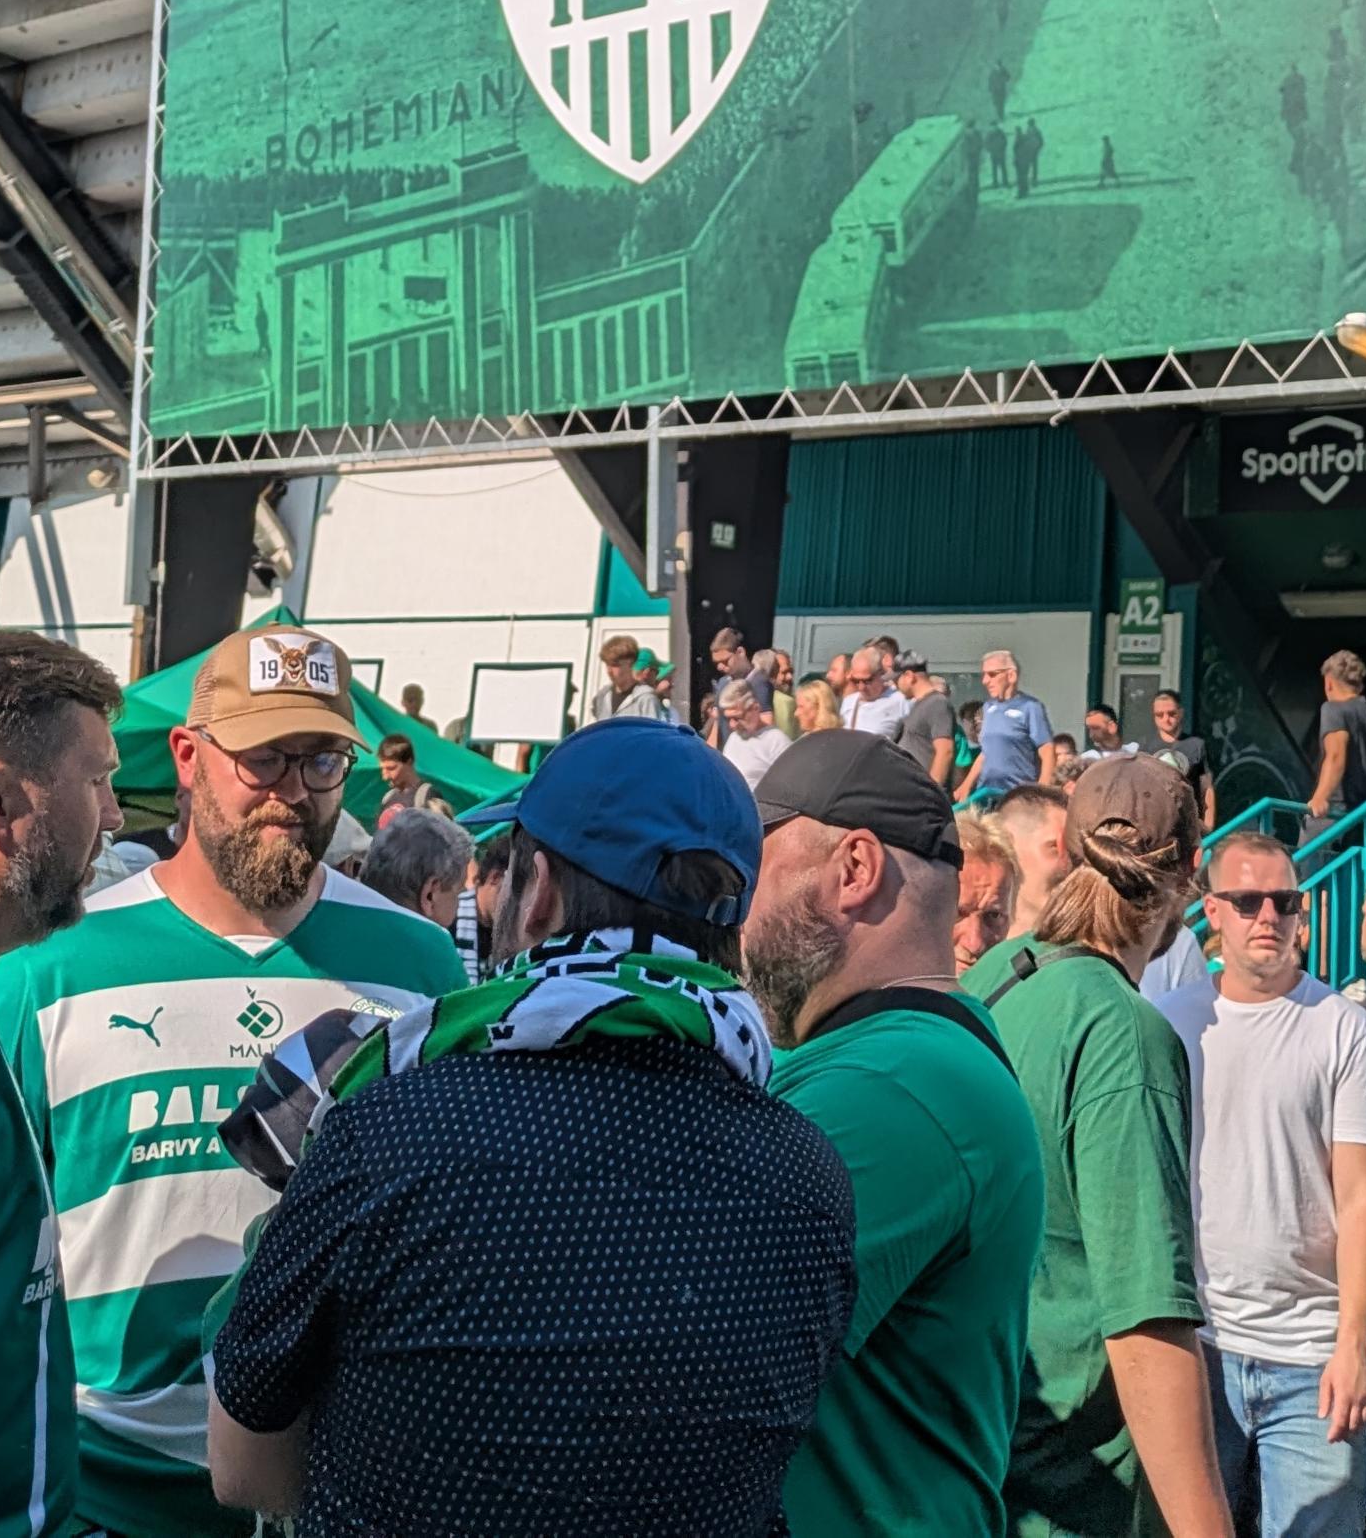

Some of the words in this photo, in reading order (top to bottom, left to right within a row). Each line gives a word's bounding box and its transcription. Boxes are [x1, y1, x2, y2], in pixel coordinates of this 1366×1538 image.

[1121, 594, 1161, 627] A2
[229, 1042, 277, 1059] MALI
[131, 1136, 203, 1164] BARVY
